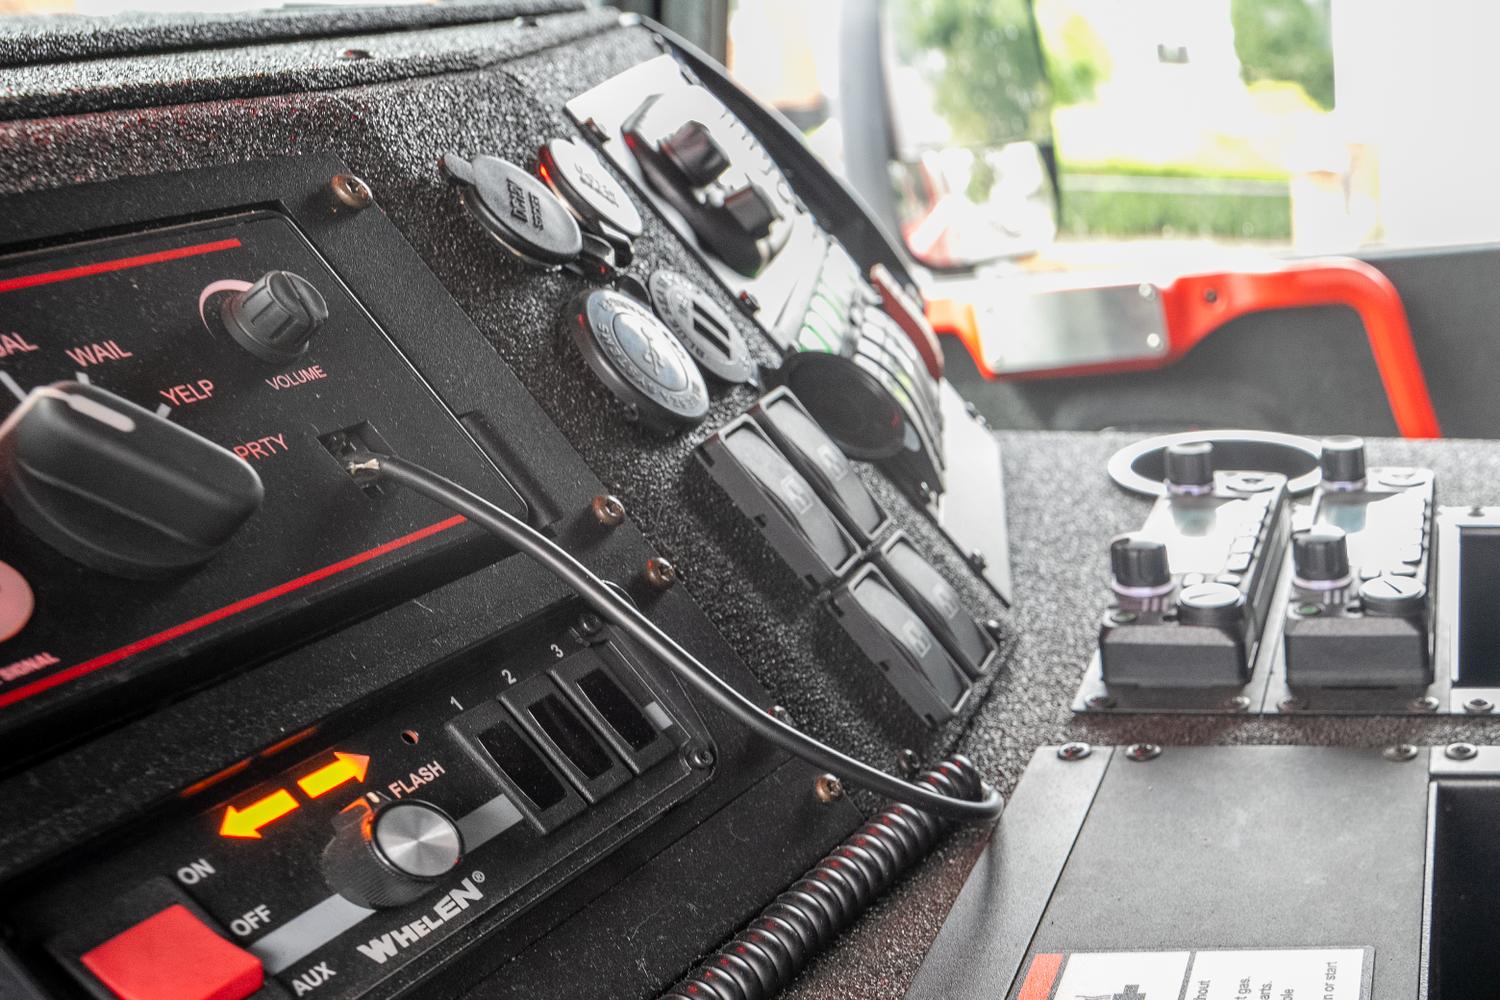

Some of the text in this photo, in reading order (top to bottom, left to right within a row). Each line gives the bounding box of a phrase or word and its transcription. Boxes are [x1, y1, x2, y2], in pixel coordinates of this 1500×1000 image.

[65, 339, 134, 368] WAIL
[265, 364, 328, 391] VOLUME
[159, 379, 215, 406] YELP
[233, 433, 289, 461] PRTY
[450, 643, 564, 711] 1 2 3
[388, 760, 446, 799] FLASH
[176, 858, 217, 885] ON
[230, 904, 273, 937] OFF
[290, 961, 337, 997] AUX
[1325, 961, 1338, 981] start
[1324, 982, 1335, 991] or
